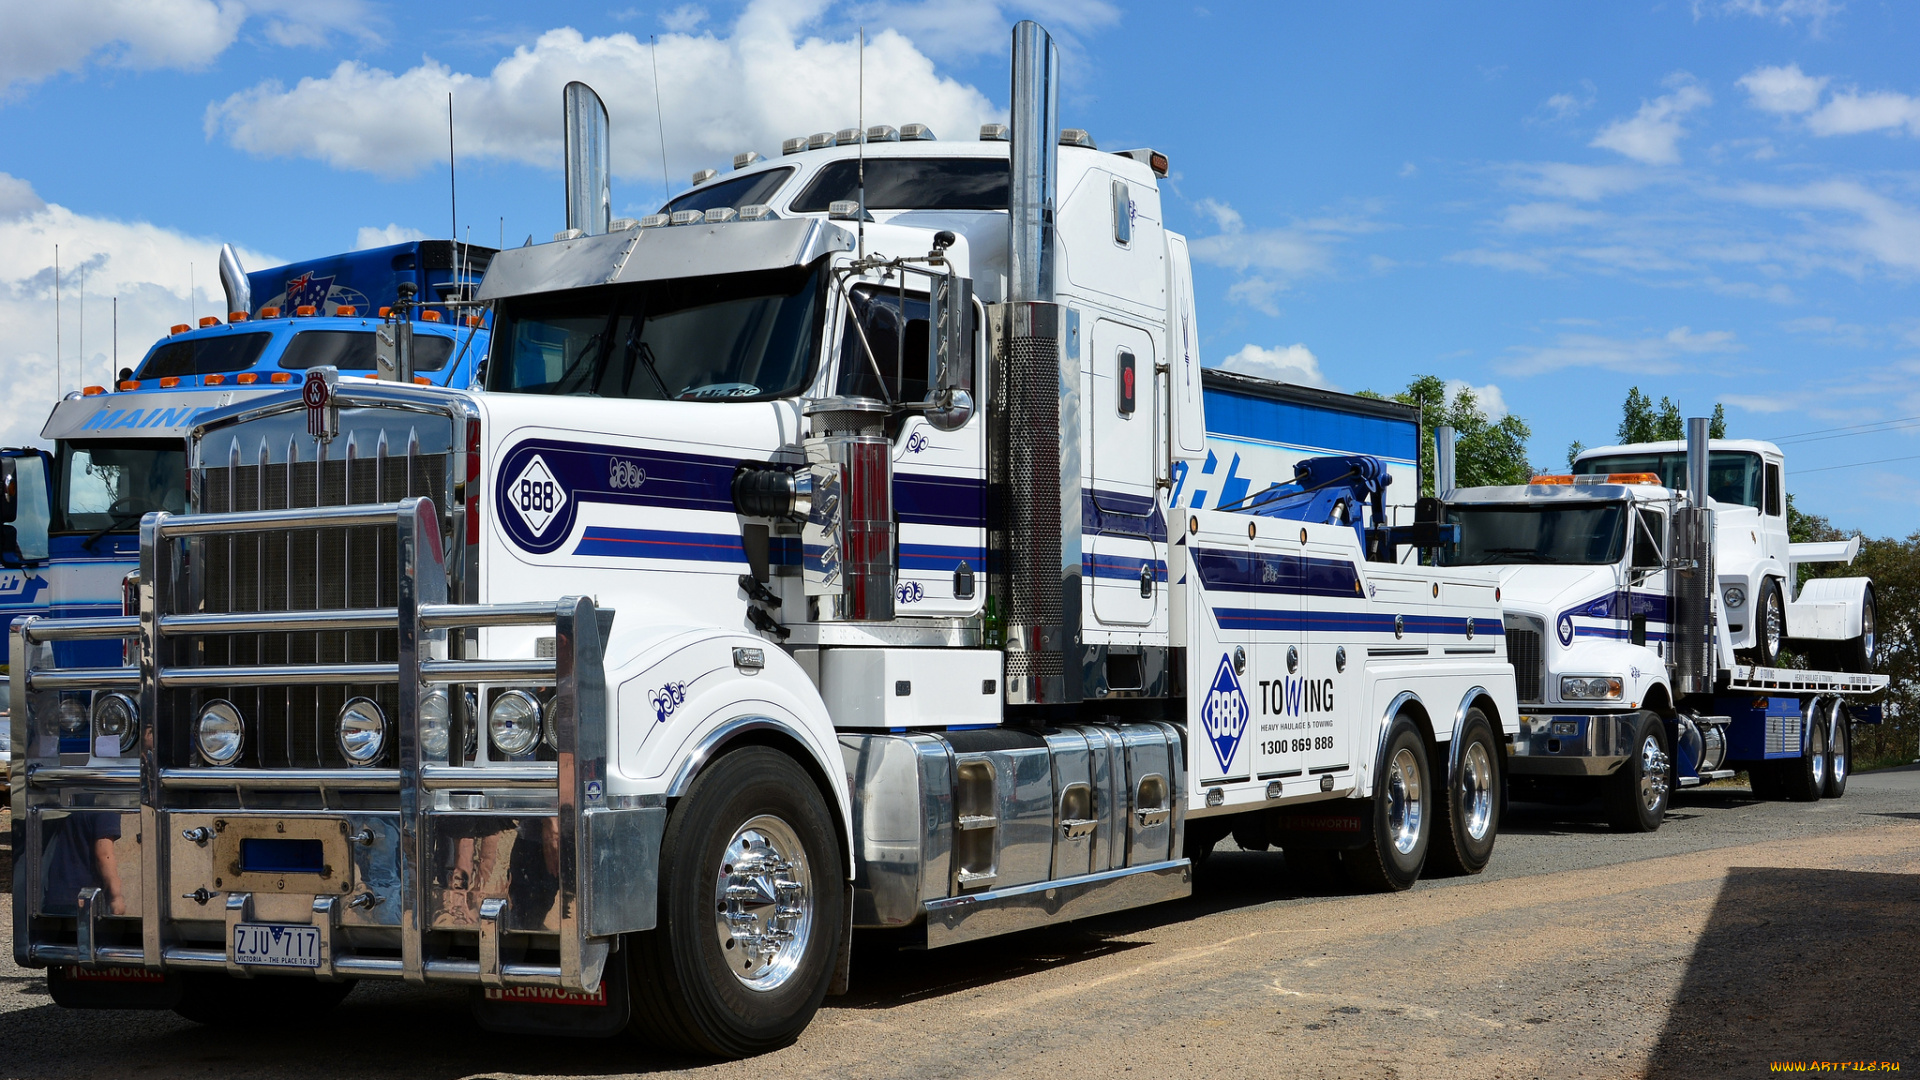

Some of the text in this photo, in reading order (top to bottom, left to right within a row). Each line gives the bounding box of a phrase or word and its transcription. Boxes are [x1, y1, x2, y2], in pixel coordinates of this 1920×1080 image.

[520, 479, 554, 513] 888
[1259, 675, 1334, 717] TOWING
[1211, 689, 1240, 740] 888
[1260, 723, 1280, 732] HEAVY
[1280, 721, 1306, 731] HAULAGE
[1312, 720, 1334, 729] TOWING
[1260, 736, 1334, 755] 1300 869 888
[237, 930, 315, 957] ZJU 717
[80, 965, 161, 978] KENWORT
[237, 955, 262, 963] VICTORIA
[269, 956, 280, 964] THE
[281, 957, 298, 965] PLACE
